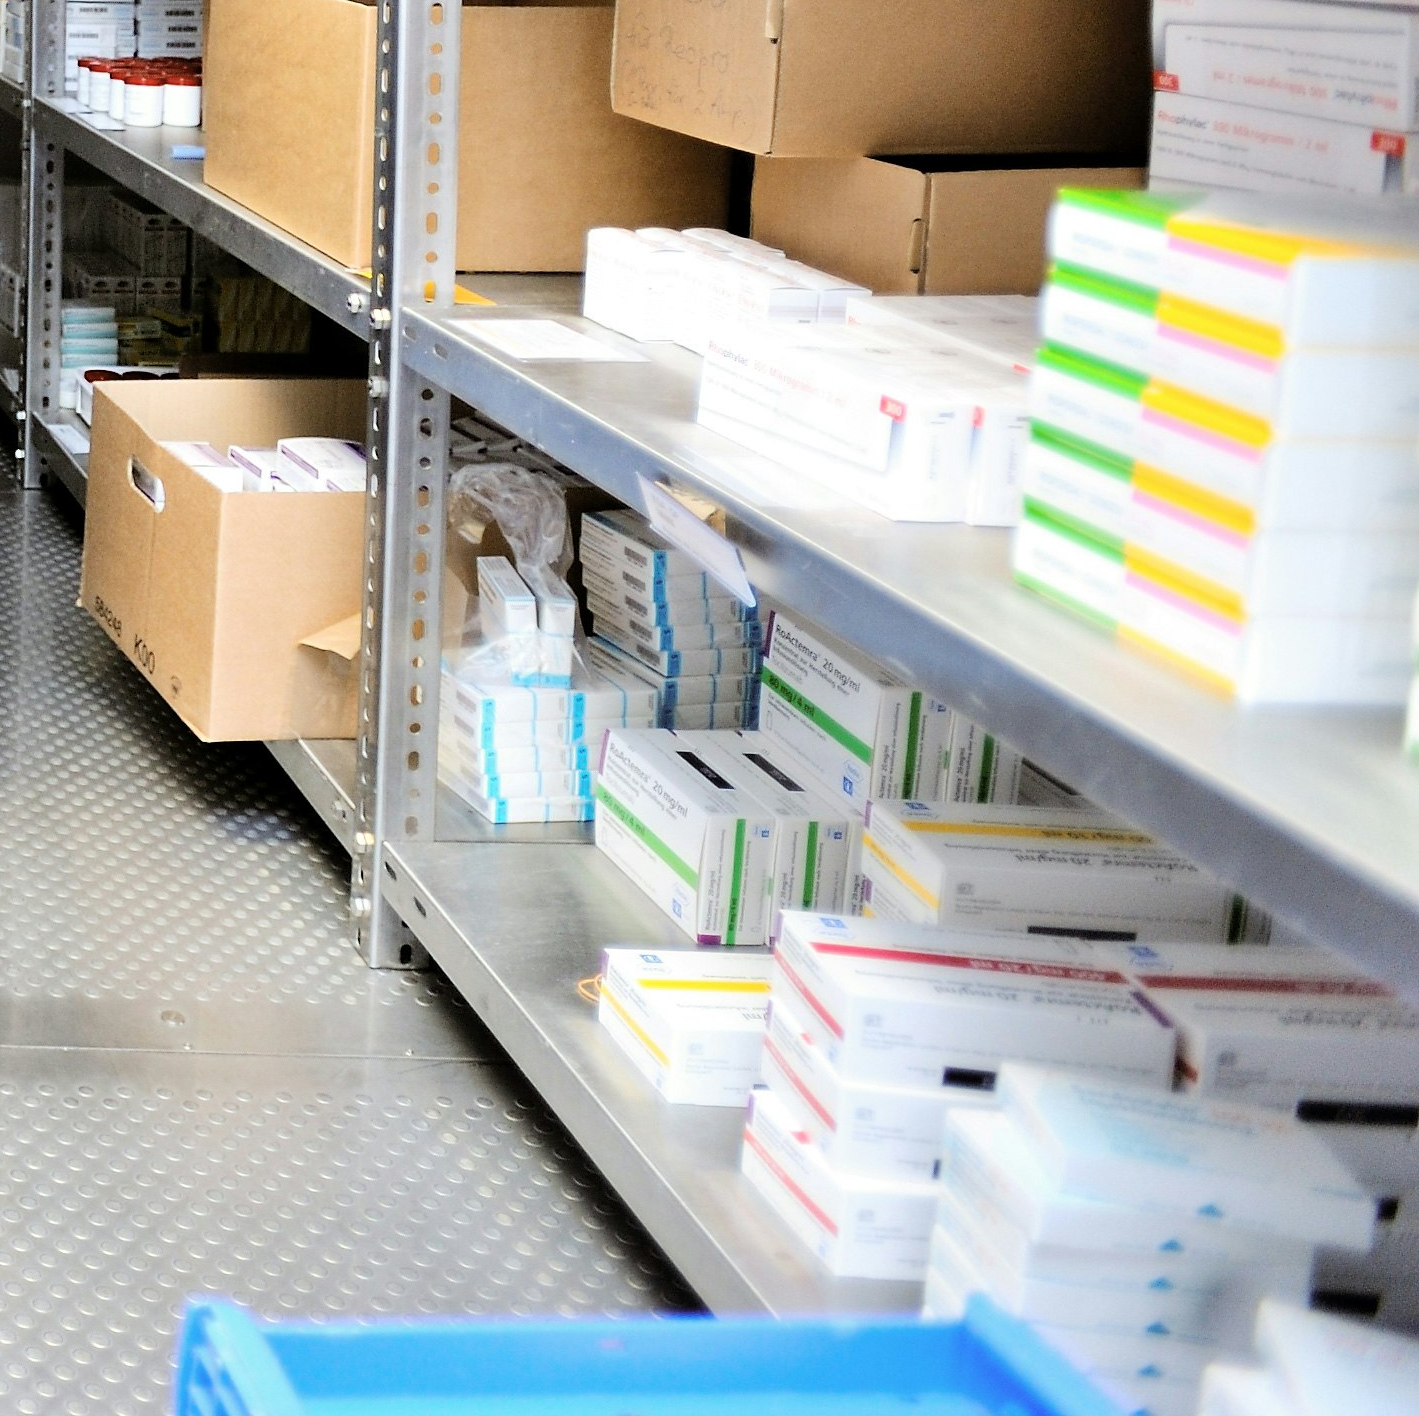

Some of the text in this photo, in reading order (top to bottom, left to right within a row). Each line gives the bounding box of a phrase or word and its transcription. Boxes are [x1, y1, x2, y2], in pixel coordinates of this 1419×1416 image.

[1158, 110, 1207, 130] Rhophylac
[708, 340, 749, 367] Rhophylac
[775, 624, 818, 662] RoActemra
[822, 658, 834, 673] 20
[833, 666, 861, 693] mg/ml
[768, 673, 815, 717] 80 mg ml
[609, 742, 689, 818] RoActemra 20 mg/ml
[613, 799, 646, 836] mg ml
